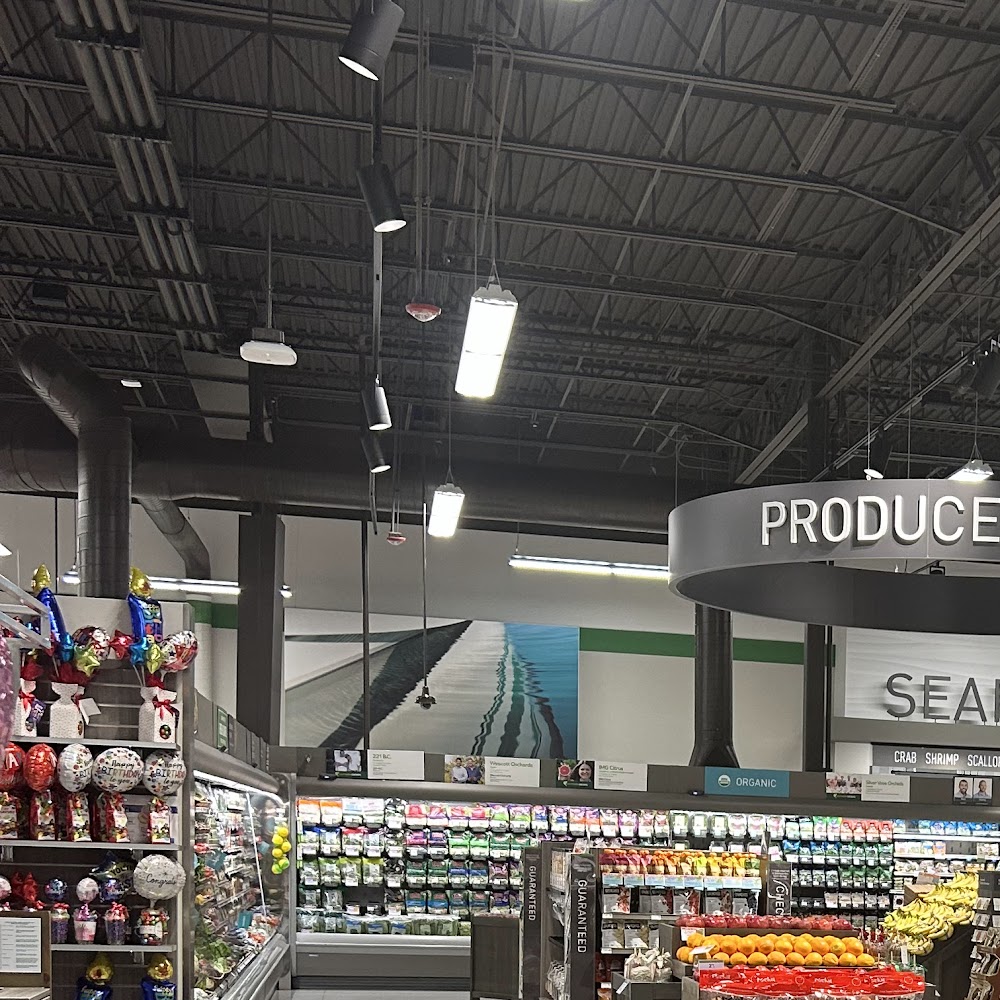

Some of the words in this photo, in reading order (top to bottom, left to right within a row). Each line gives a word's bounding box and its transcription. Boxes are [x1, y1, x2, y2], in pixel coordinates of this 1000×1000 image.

[761, 495, 1000, 545] PRODUCE
[894, 751, 917, 764] CRAB
[925, 752, 959, 766] SHRIMP
[736, 777, 777, 788] ORGANIC
[528, 865, 537, 921] GUARANTEED
[775, 886, 785, 918] CHEC
[577, 879, 588, 954] GUARANTEED
